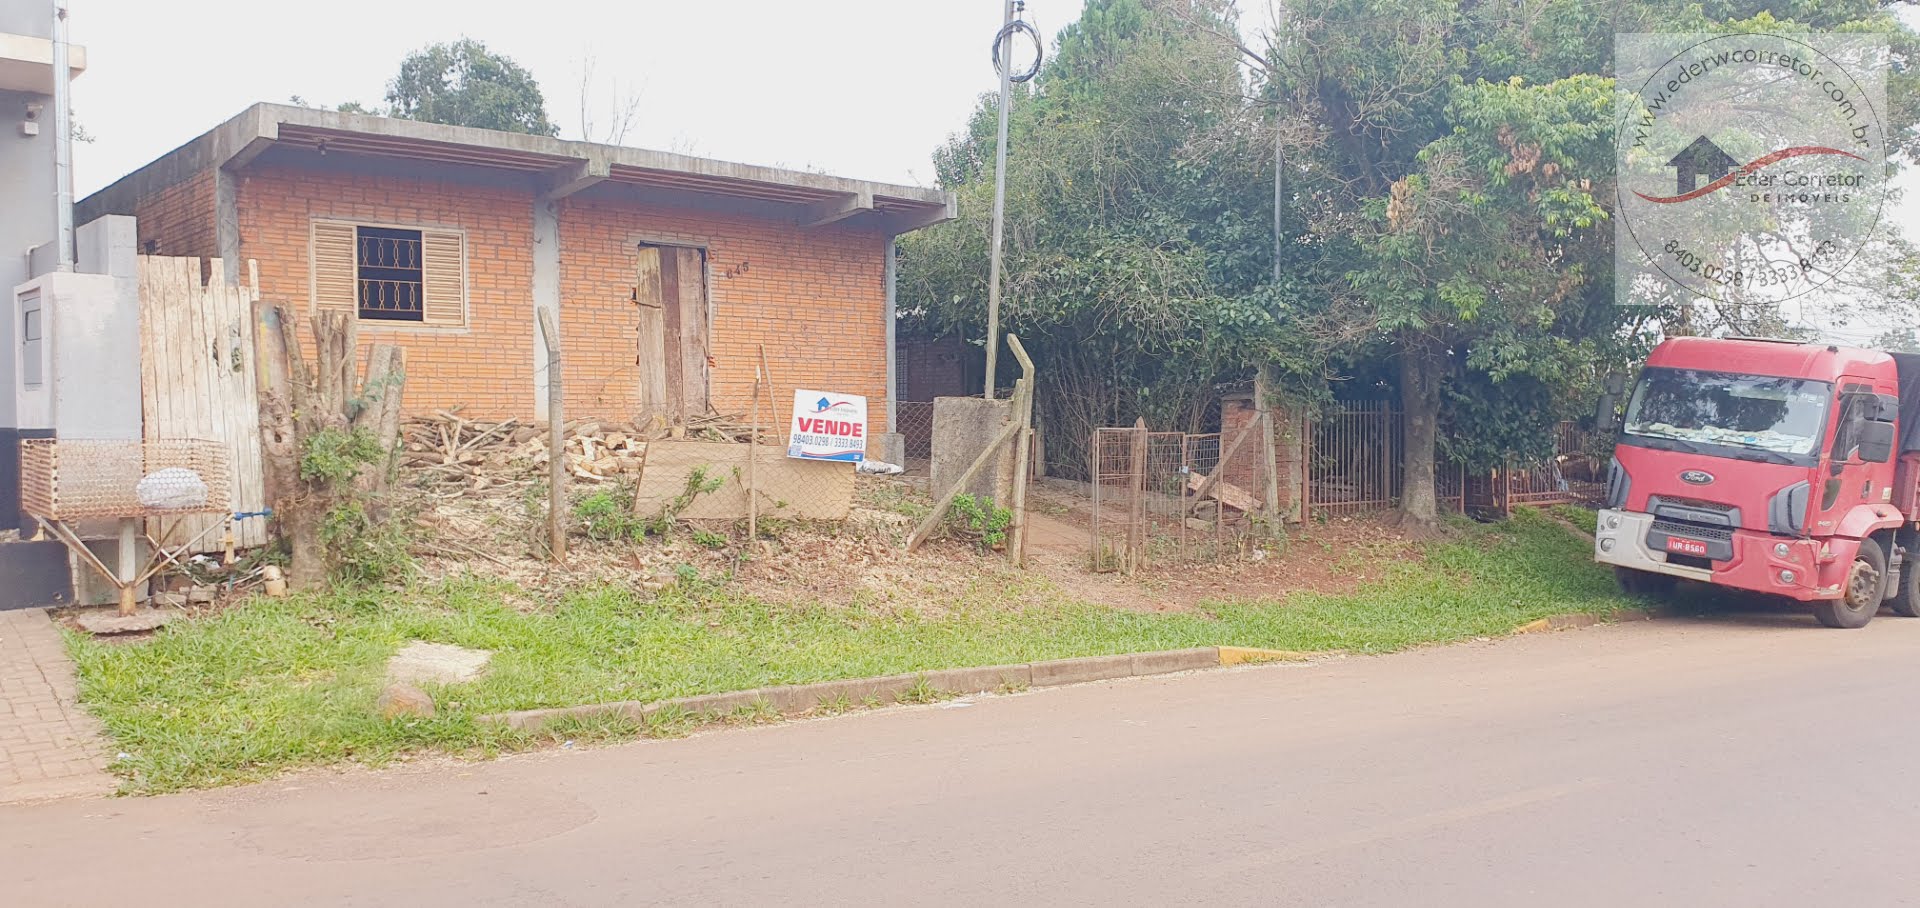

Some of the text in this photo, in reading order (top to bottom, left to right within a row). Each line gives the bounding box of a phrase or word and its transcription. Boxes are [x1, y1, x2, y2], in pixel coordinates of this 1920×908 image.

[798, 416, 863, 438] VENDE
[792, 433, 830, 447] 98403.0298
[834, 437, 864, 450] 3333.8493
[1685, 471, 1706, 482] Ford
